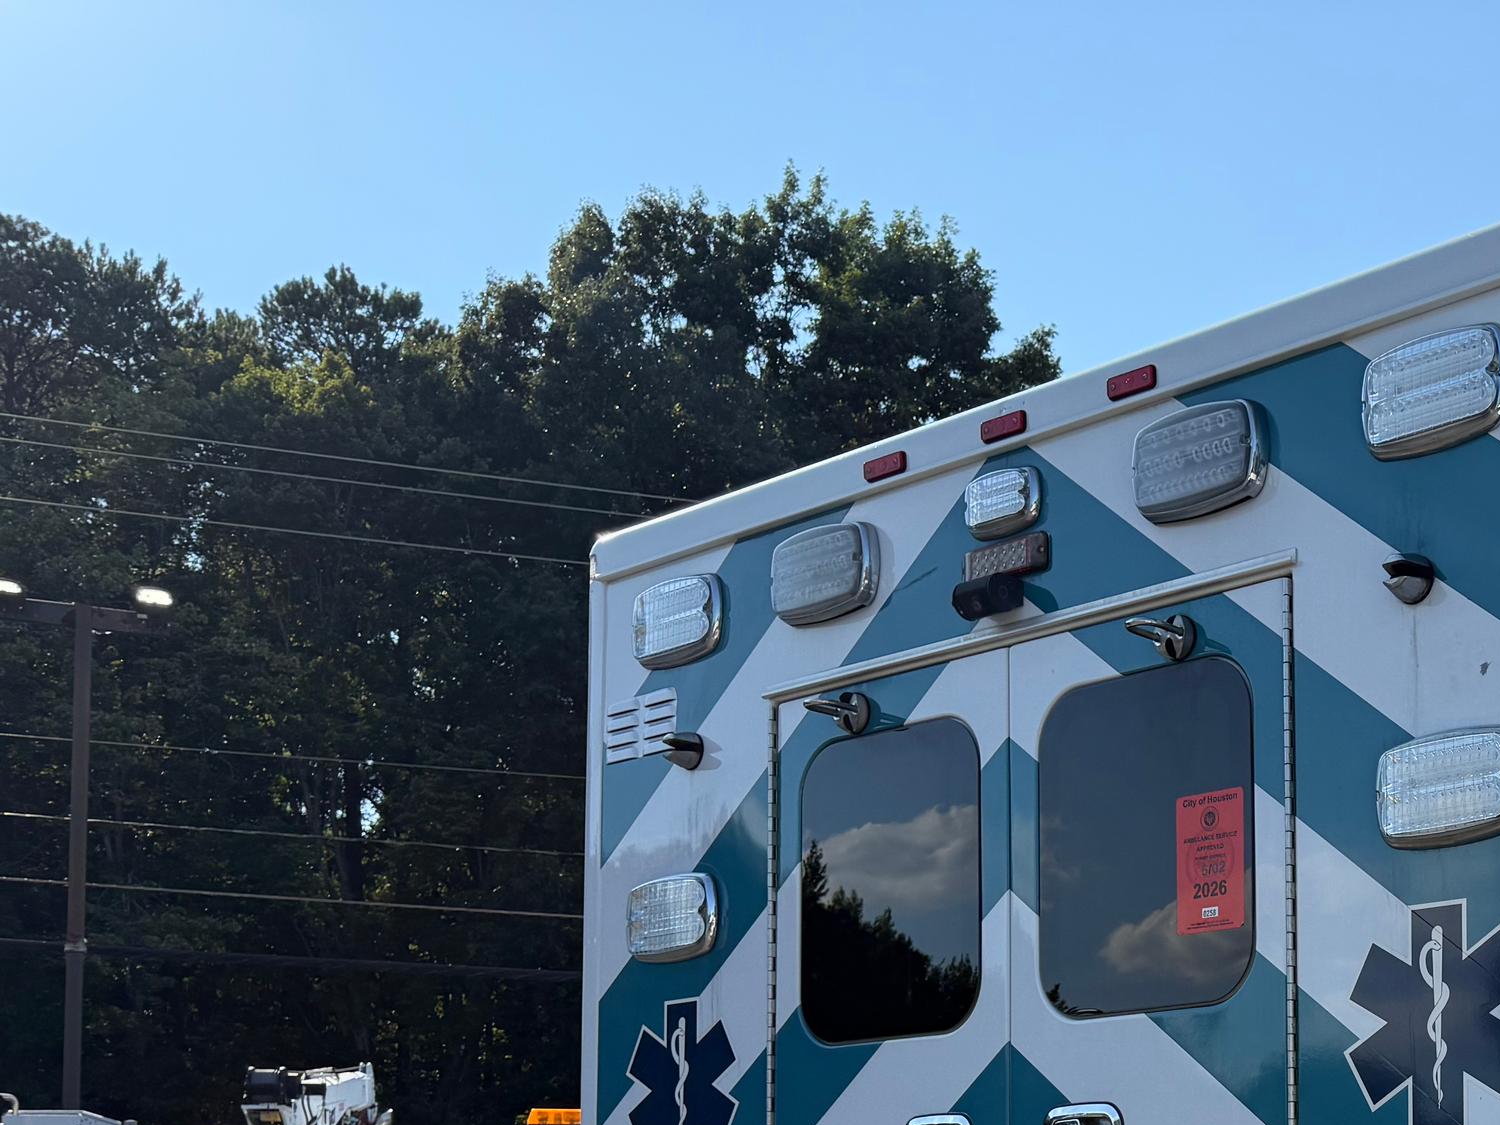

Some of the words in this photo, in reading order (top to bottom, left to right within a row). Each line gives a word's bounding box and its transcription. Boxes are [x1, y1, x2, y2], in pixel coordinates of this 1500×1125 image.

[1182, 799, 1197, 808] City
[1198, 796, 1206, 805] of
[1207, 792, 1238, 804] Houston
[1193, 880, 1228, 899] 2026
